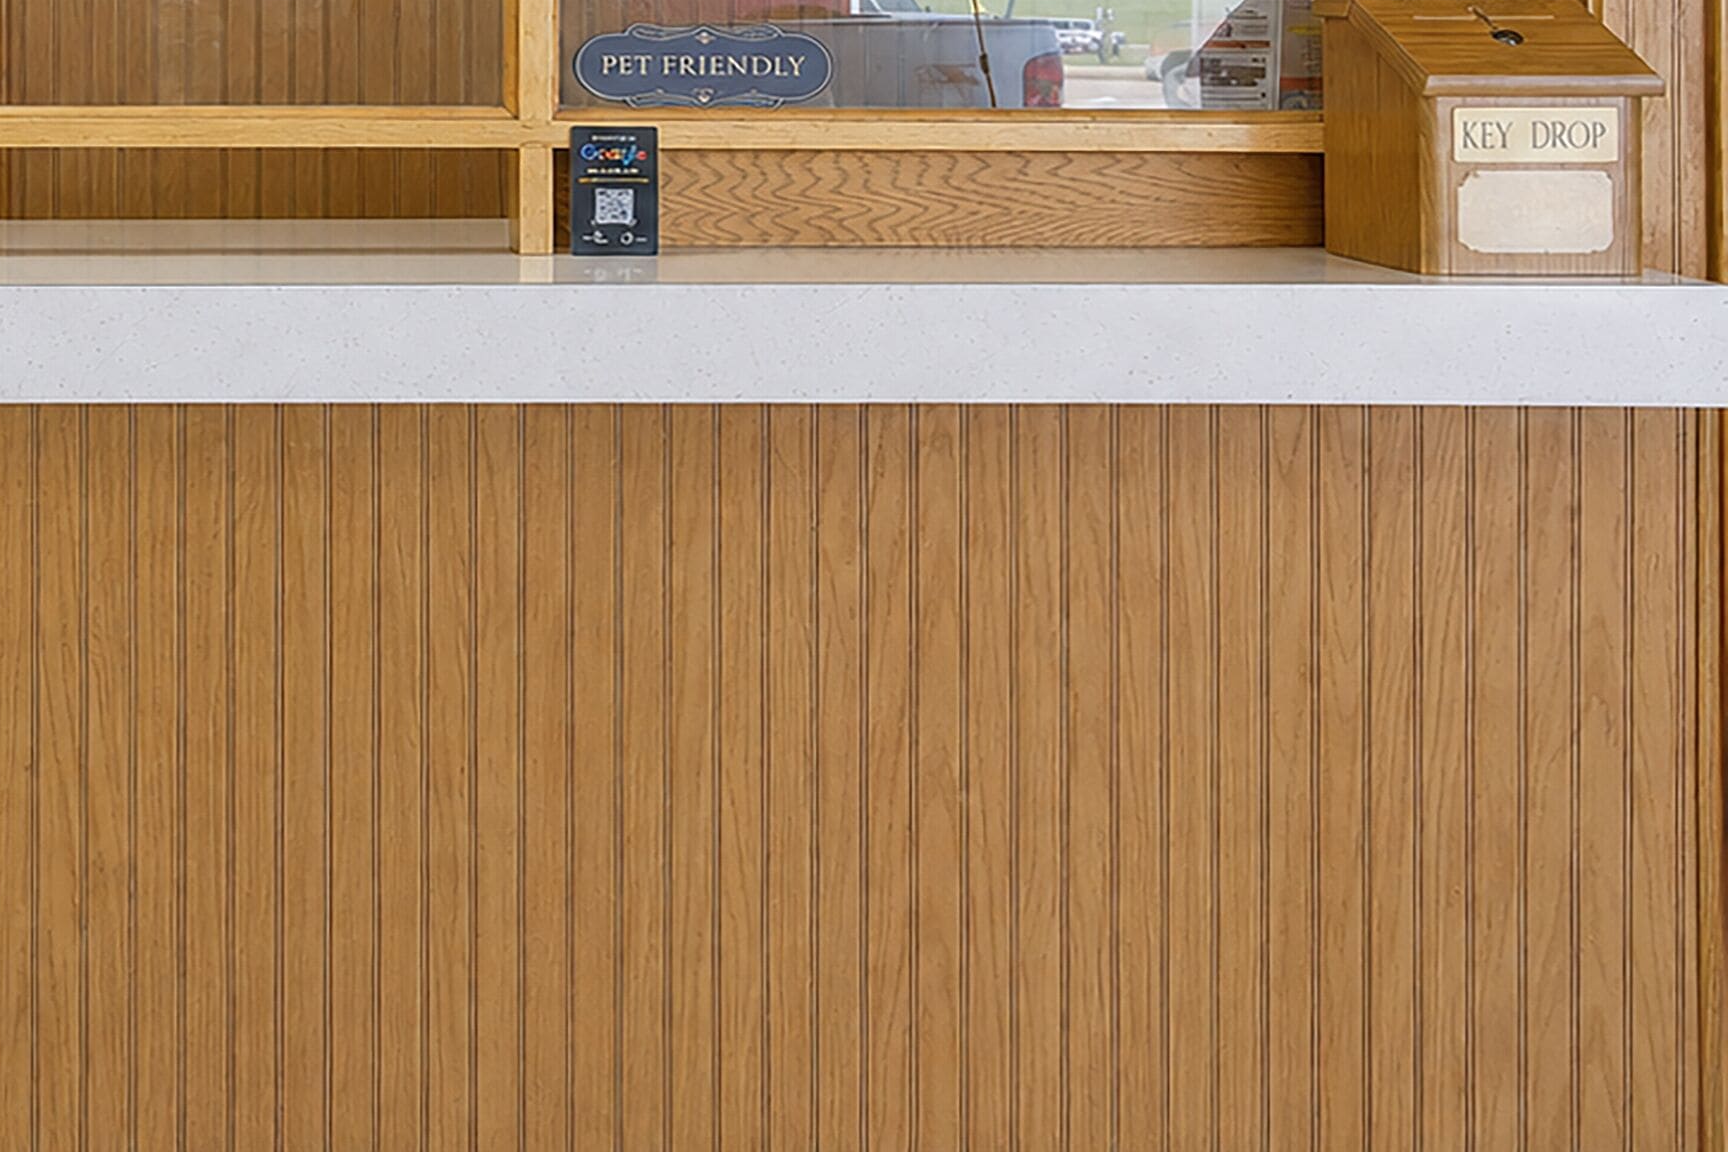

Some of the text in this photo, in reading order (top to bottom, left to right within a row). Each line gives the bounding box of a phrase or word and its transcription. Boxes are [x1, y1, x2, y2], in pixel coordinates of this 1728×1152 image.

[602, 55, 806, 77] PET FRIENDLY
[1462, 120, 1607, 149] KEY DROP
